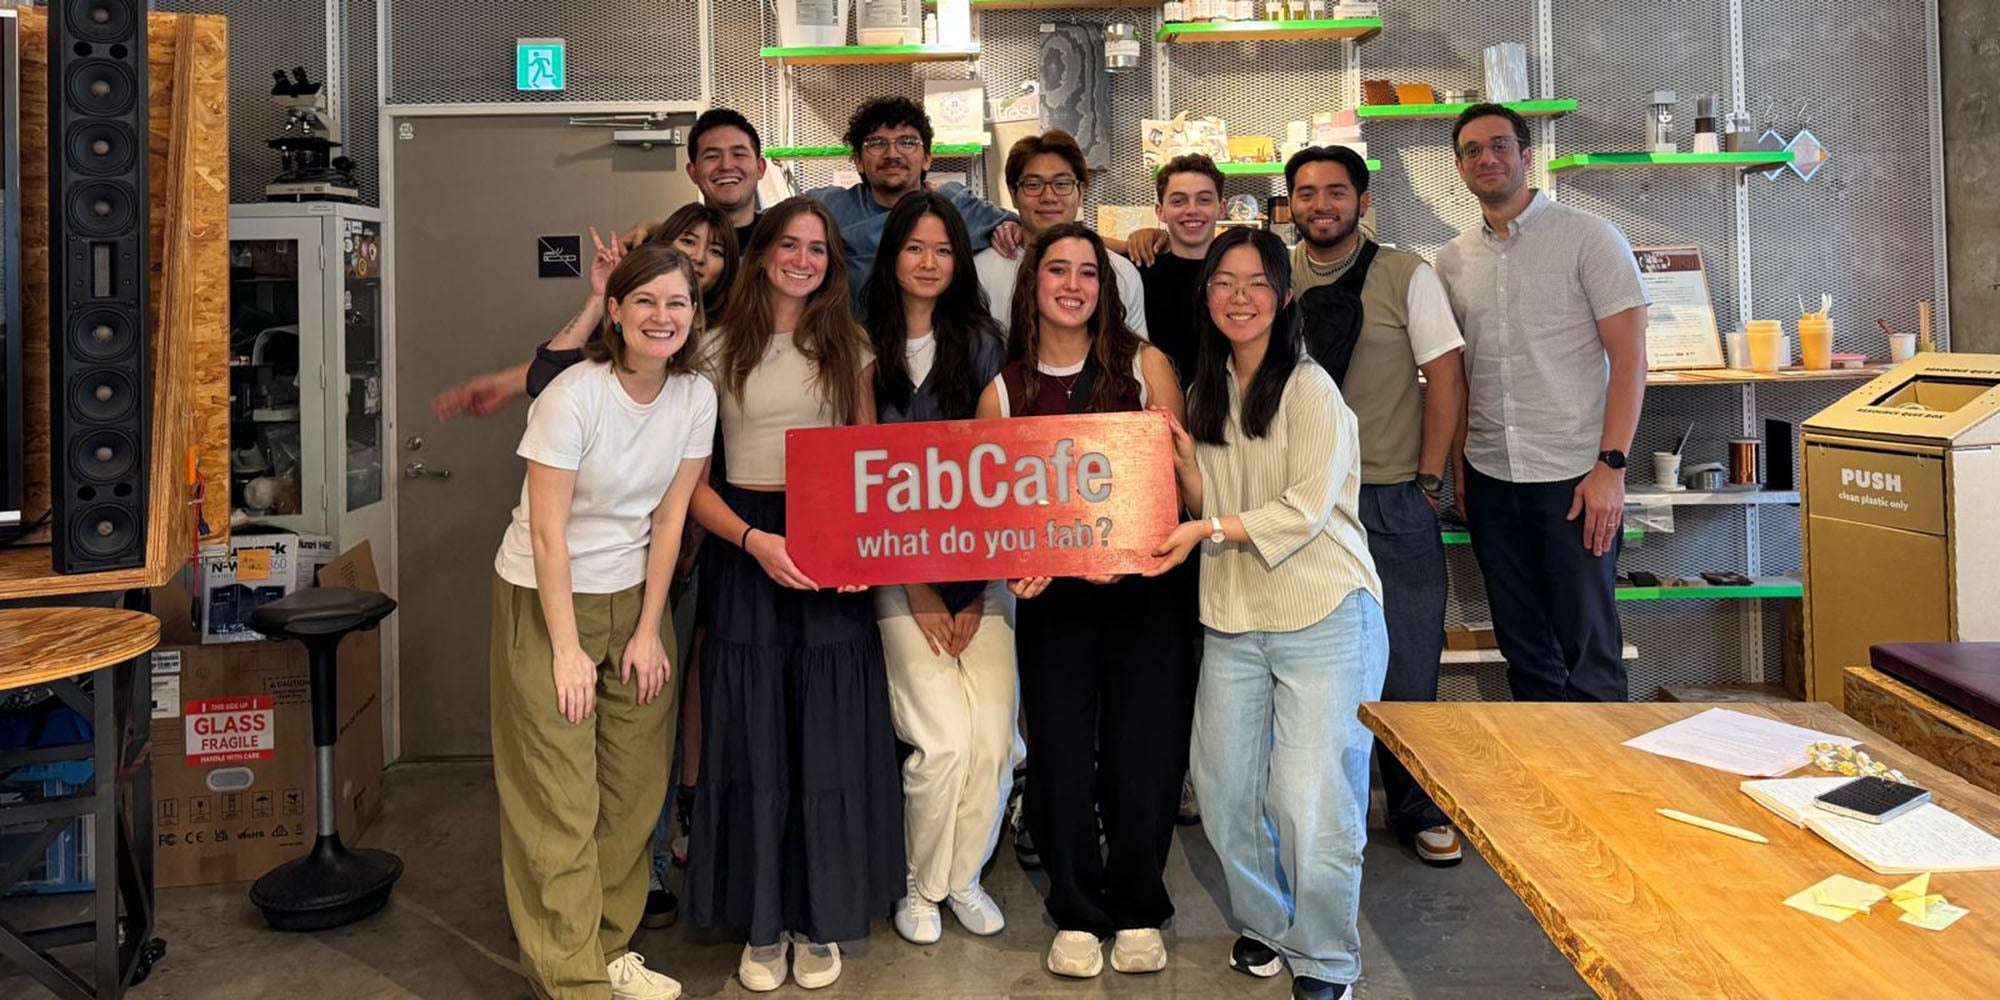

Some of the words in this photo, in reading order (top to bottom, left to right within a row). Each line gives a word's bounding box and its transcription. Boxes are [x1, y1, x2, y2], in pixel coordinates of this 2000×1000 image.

[854, 439, 1112, 513] FabCafe
[1841, 467, 1902, 492] PUSH
[1838, 491, 1860, 503] clean
[1861, 494, 1889, 507] plastic
[1890, 499, 1909, 512] only
[856, 526, 930, 558] what
[939, 525, 975, 554] do
[984, 524, 1036, 559] you
[1046, 517, 1113, 550] fab?
[211, 703, 225, 711] THIS
[194, 713, 266, 735] GLASS
[201, 735, 259, 750] FRAGILE
[200, 754, 226, 763] HANDLE
[226, 753, 243, 761] WITH
[243, 752, 260, 760] CARE
